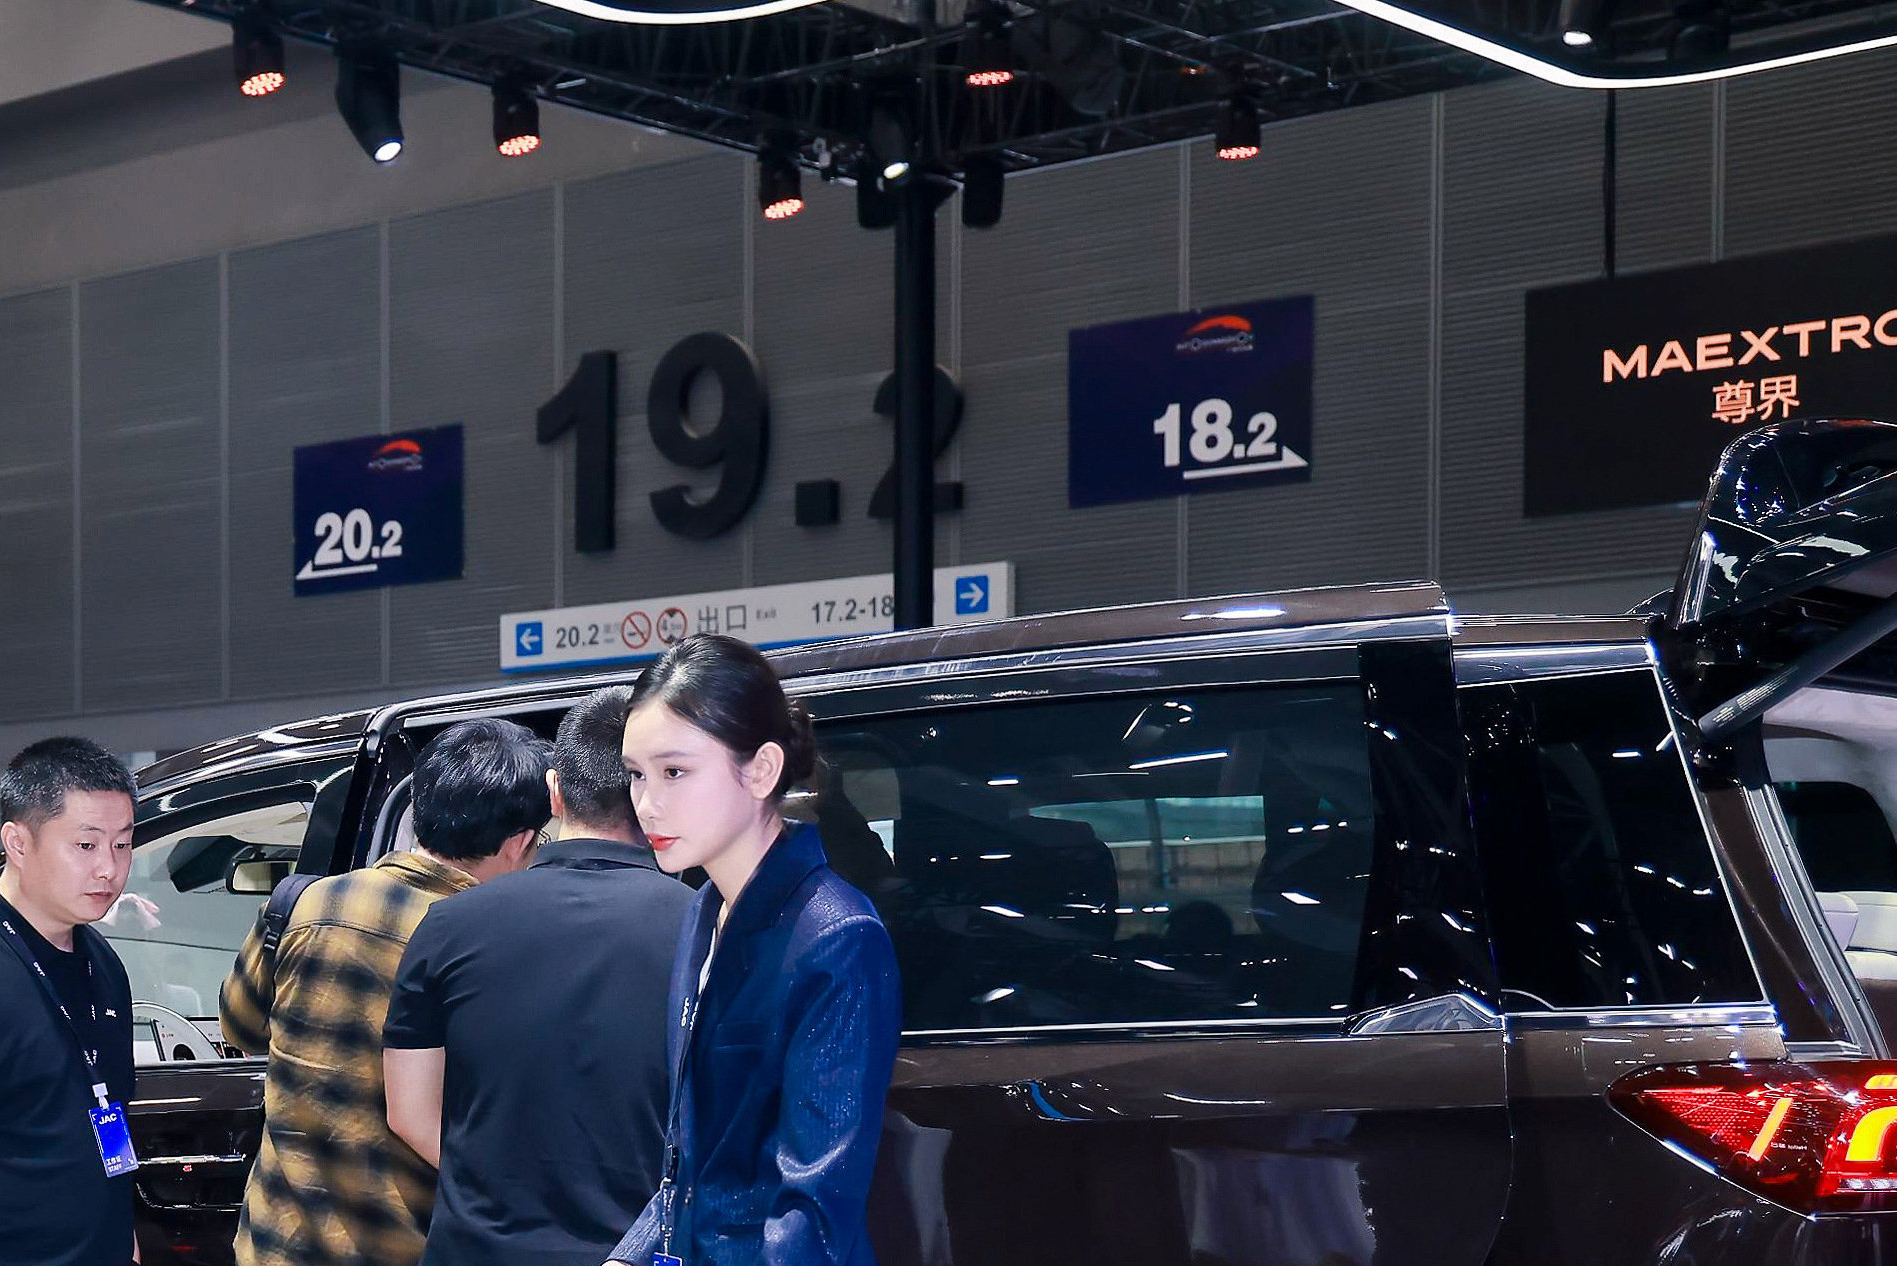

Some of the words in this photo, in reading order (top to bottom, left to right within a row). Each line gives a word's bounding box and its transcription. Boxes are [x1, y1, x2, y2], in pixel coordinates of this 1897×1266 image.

[1711, 373, 1800, 424] 尊界
[536, 331, 964, 553] 19.2
[1154, 398, 1277, 467] 18.2
[314, 508, 402, 566] 20.2
[555, 624, 599, 649] 20.2
[697, 604, 746, 634] 出口
[99, 1113, 118, 1125] JAC
